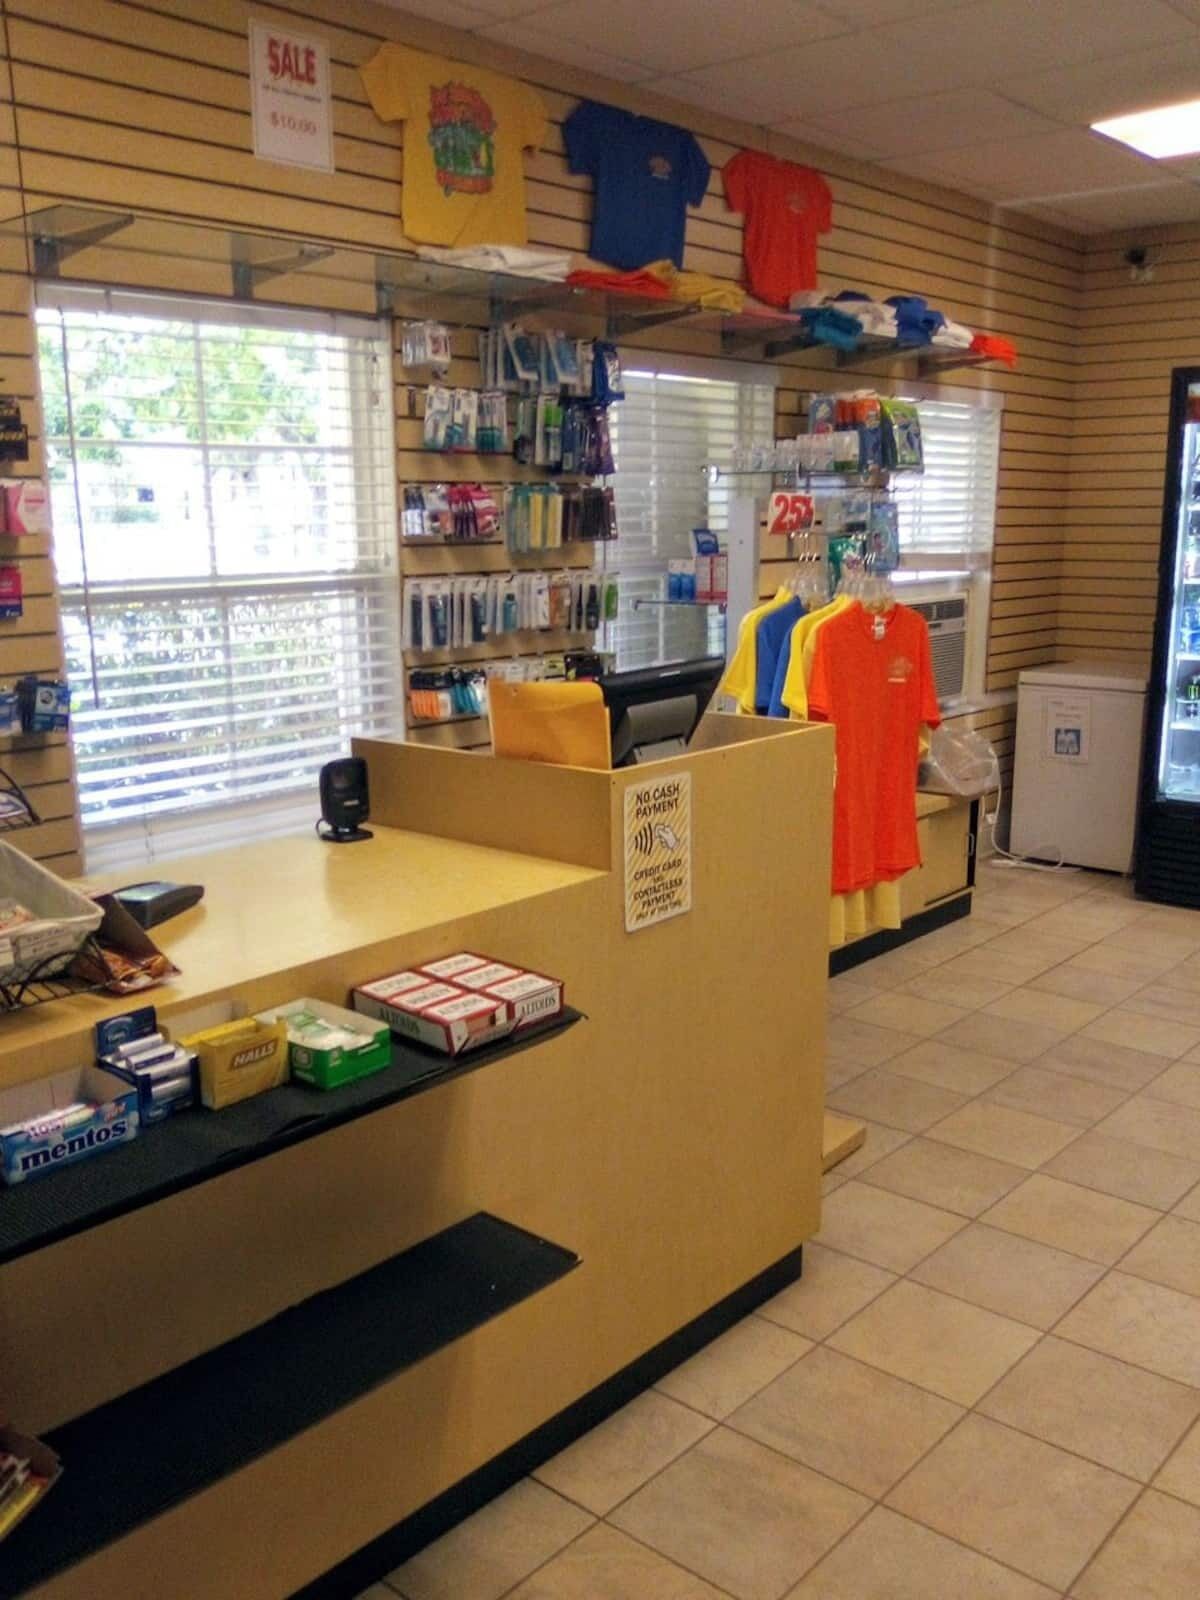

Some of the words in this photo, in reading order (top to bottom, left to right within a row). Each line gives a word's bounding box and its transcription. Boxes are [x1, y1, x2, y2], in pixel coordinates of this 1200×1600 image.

[267, 36, 316, 86] SALE
[636, 791, 650, 806] NO
[652, 783, 680, 801] CASH
[636, 798, 679, 819] PAYMENT
[634, 864, 661, 881] CREDIT
[662, 858, 682, 872] CARD
[641, 891, 676, 910] PAYMENT
[520, 996, 556, 1017] ALTOIDS
[232, 1041, 276, 1067] HALLS
[21, 1119, 128, 1172] mentos
